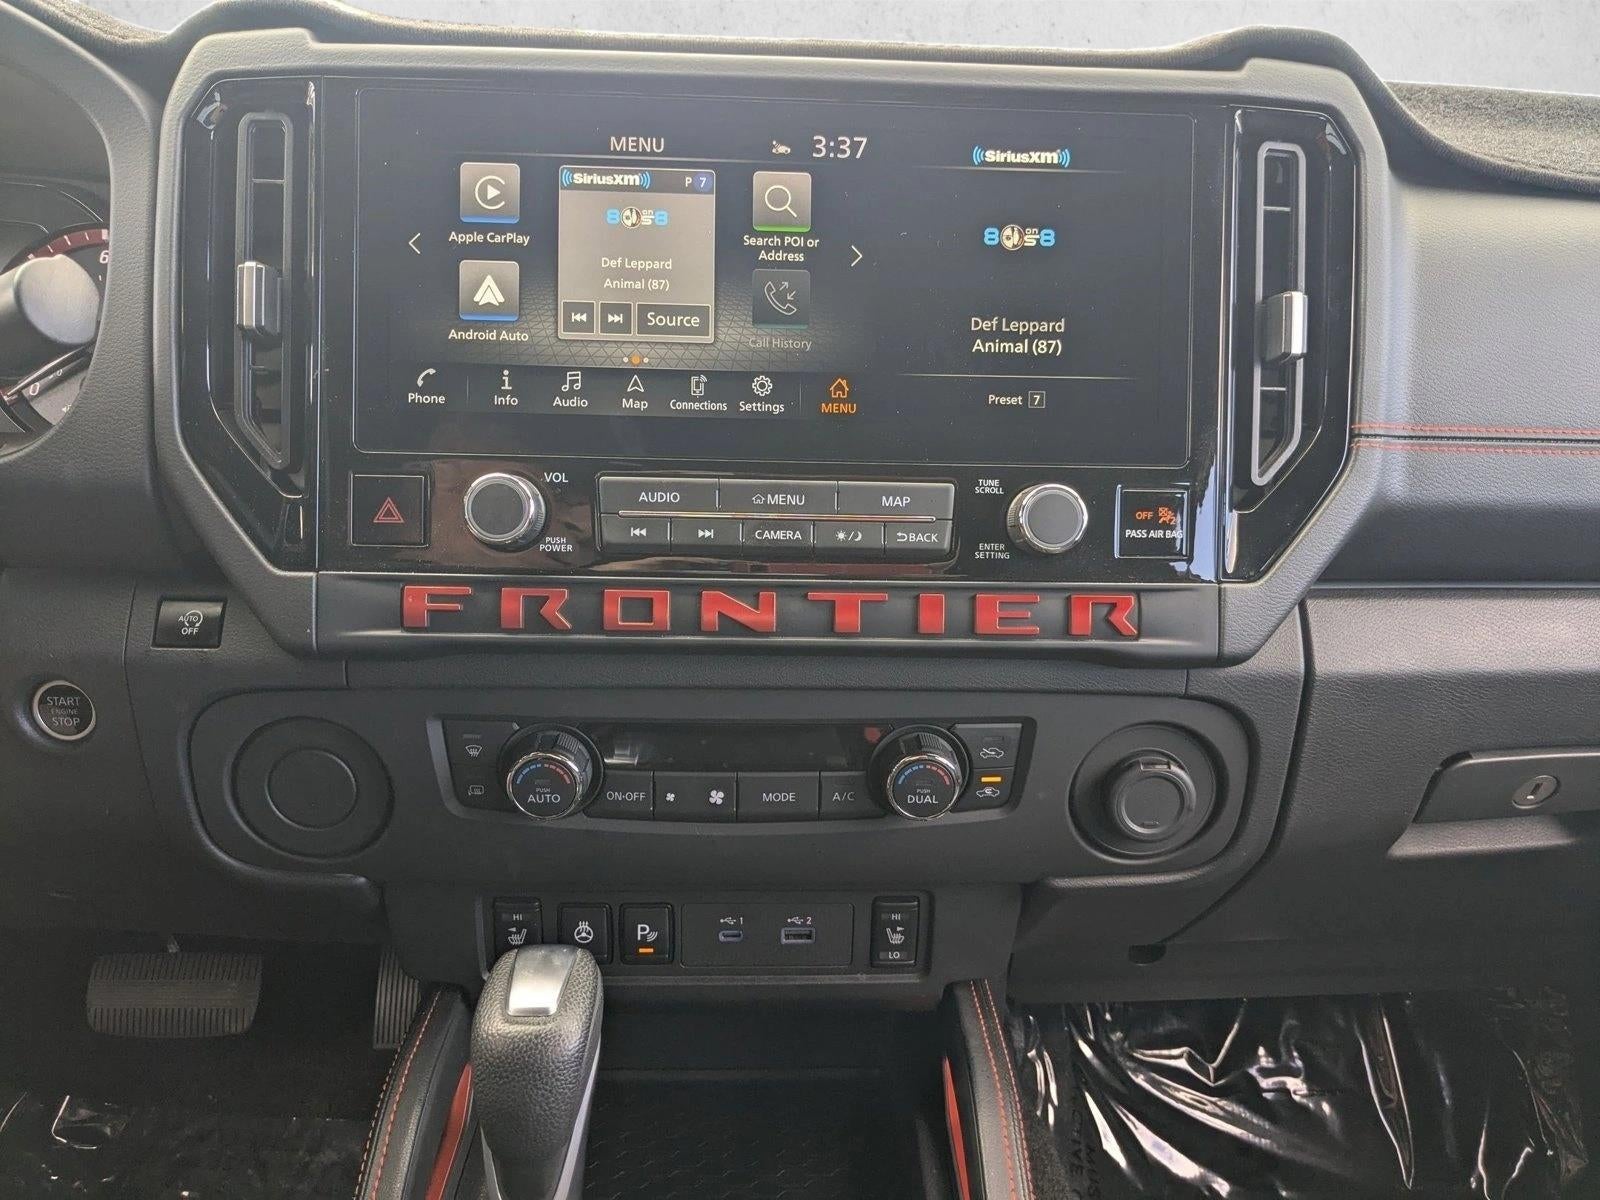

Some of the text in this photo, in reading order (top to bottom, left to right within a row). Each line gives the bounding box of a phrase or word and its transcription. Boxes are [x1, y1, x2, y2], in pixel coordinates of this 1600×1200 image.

[610, 136, 665, 153] MENU
[812, 135, 868, 159] 3:37
[685, 177, 707, 188] P 7
[449, 231, 530, 246] Apple CarPlay
[743, 235, 820, 249] Search POI or
[758, 250, 805, 262] Address
[601, 257, 673, 272] Def Leppard
[604, 278, 670, 292] Animal (87)
[647, 312, 700, 327] Source
[971, 317, 1066, 336] Def Leppard
[449, 329, 530, 342] Android Auto
[749, 337, 812, 352] Call History
[972, 339, 1063, 357] Animal (87)
[408, 392, 446, 405] Phone
[494, 394, 518, 406] Info
[553, 396, 588, 408] Audio
[622, 398, 648, 411] Map
[988, 394, 1040, 406] Preset 7
[669, 399, 728, 412] Connections
[739, 400, 785, 414] Settings
[821, 402, 857, 414] MENU
[544, 472, 569, 483] VOL
[978, 479, 1000, 487] TUNE
[975, 486, 1004, 495] SCROLL
[638, 491, 680, 503] AUDIO
[767, 493, 805, 506] MENU
[881, 495, 911, 507] MAP
[1135, 511, 1153, 520] OFF
[755, 529, 802, 541] CAMERA
[909, 532, 938, 543] BACK
[1125, 529, 1183, 539] PASS AIR BAG
[545, 537, 567, 545] PUSH
[979, 543, 1005, 551] ENTER
[539, 544, 573, 552] POWER
[975, 551, 1010, 560] SETTING
[401, 584, 1139, 638] FRONTIER
[181, 627, 199, 636] OFF
[46, 696, 80, 707] START
[52, 717, 80, 727] STOP
[527, 794, 561, 804] AUTO
[762, 792, 796, 802] MODE
[832, 791, 855, 802] A/C
[907, 794, 939, 804] DUAL
[512, 913, 523, 921] HI
[806, 916, 812, 925] 2
[891, 913, 901, 921] HI
[637, 924, 650, 941] P
[888, 951, 900, 959] LO
